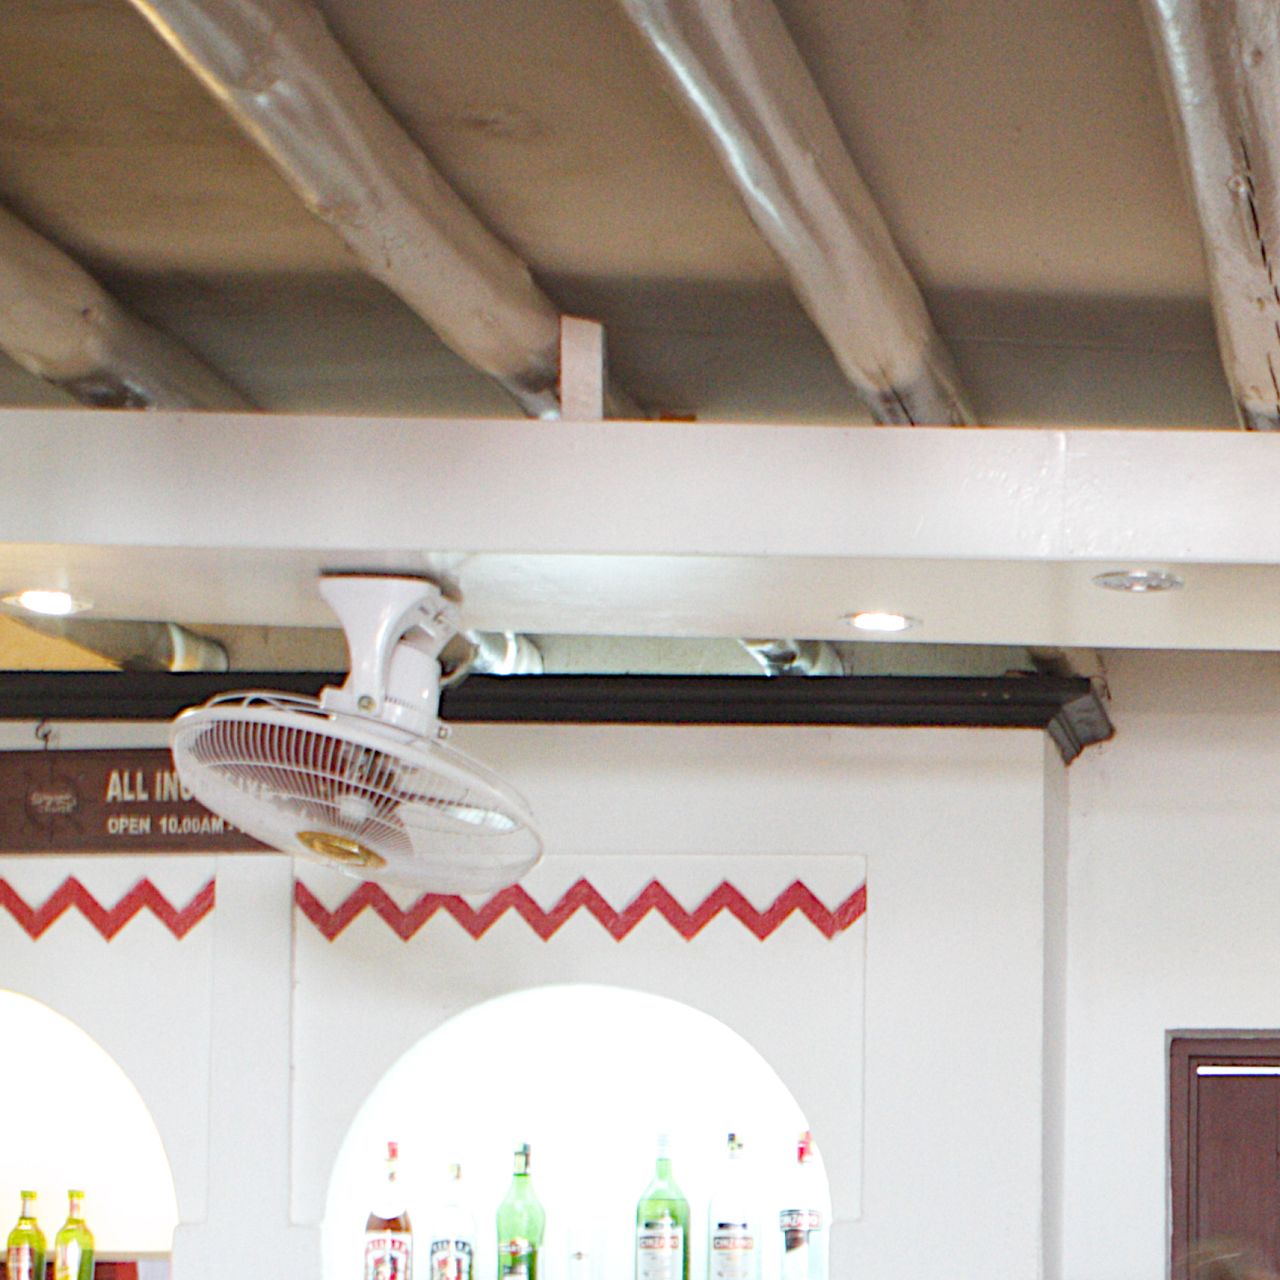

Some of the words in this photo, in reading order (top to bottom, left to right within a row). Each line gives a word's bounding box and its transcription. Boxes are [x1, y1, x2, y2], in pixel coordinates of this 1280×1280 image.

[106, 769, 149, 802] ALL
[107, 814, 152, 836] OPEN
[159, 815, 225, 836] 10.00AM
